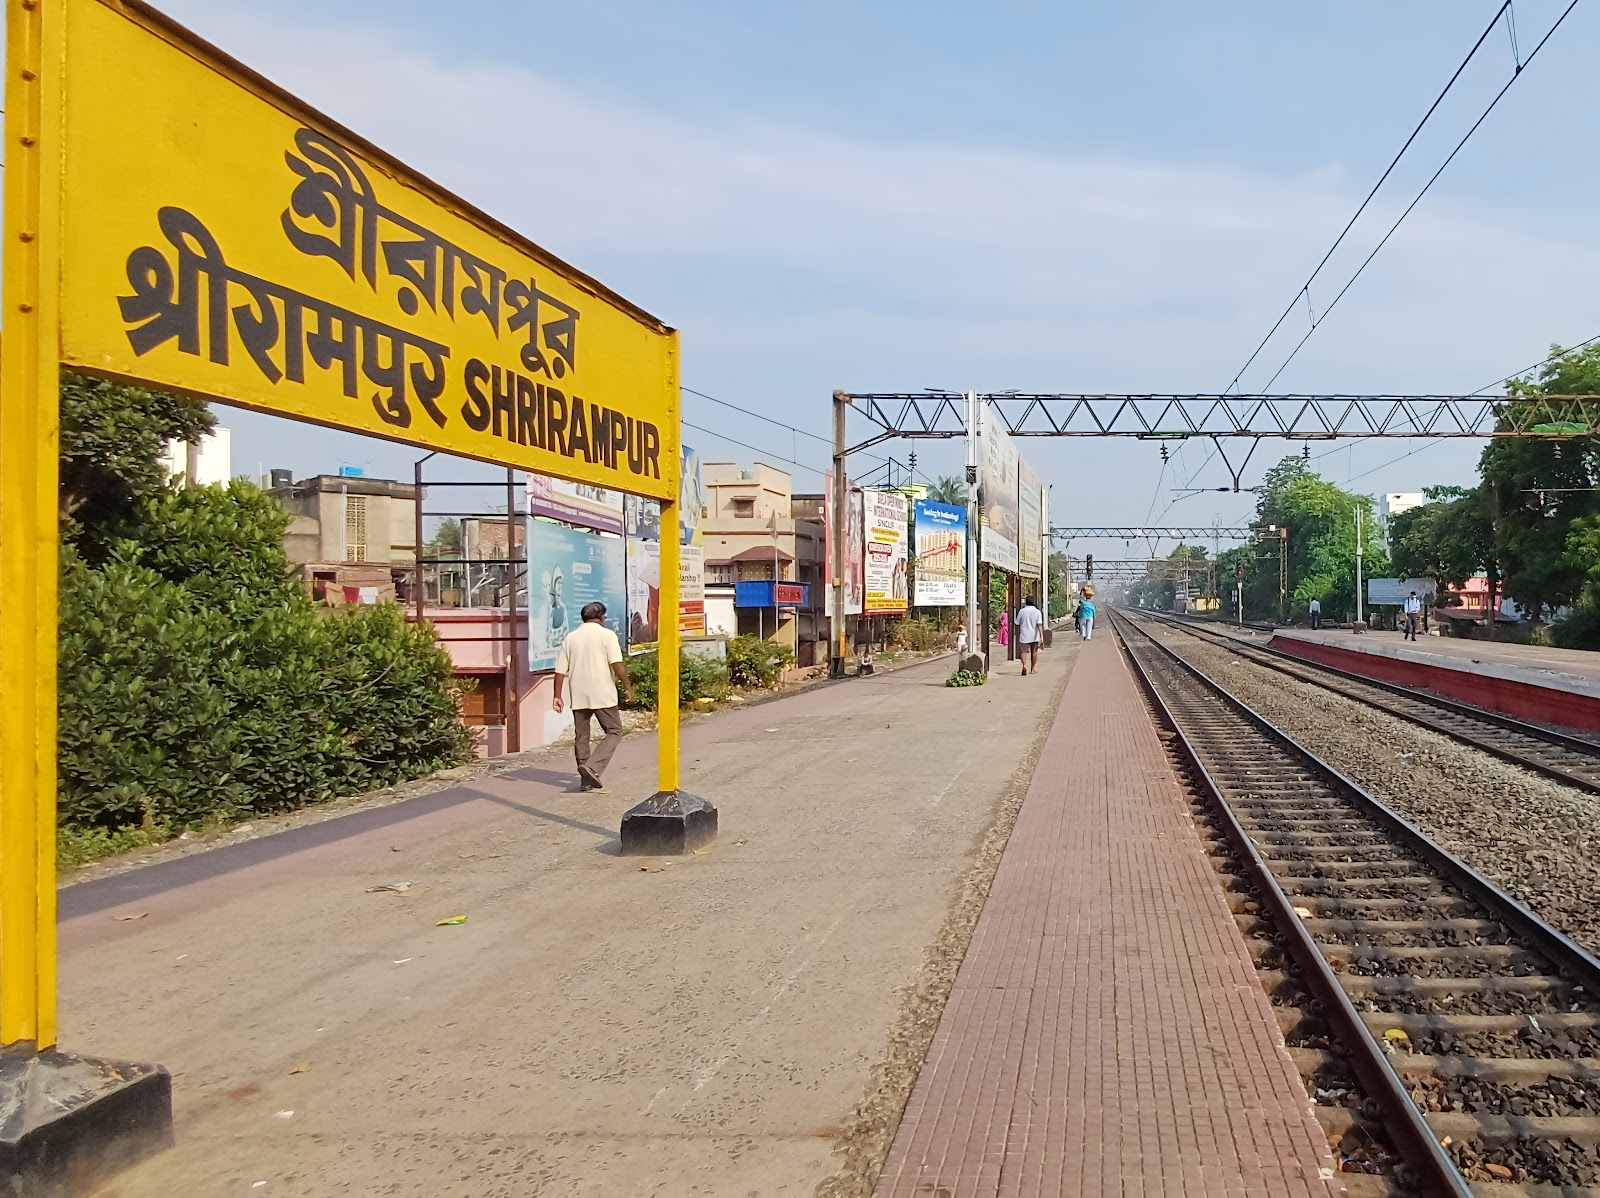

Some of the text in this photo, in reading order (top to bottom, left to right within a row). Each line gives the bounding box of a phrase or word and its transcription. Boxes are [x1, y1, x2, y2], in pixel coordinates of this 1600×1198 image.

[117, 206, 450, 428] श्रीरामपुर
[281, 127, 580, 379] শ্রীরামপুর
[461, 358, 661, 480] SHRIRAMPUR
